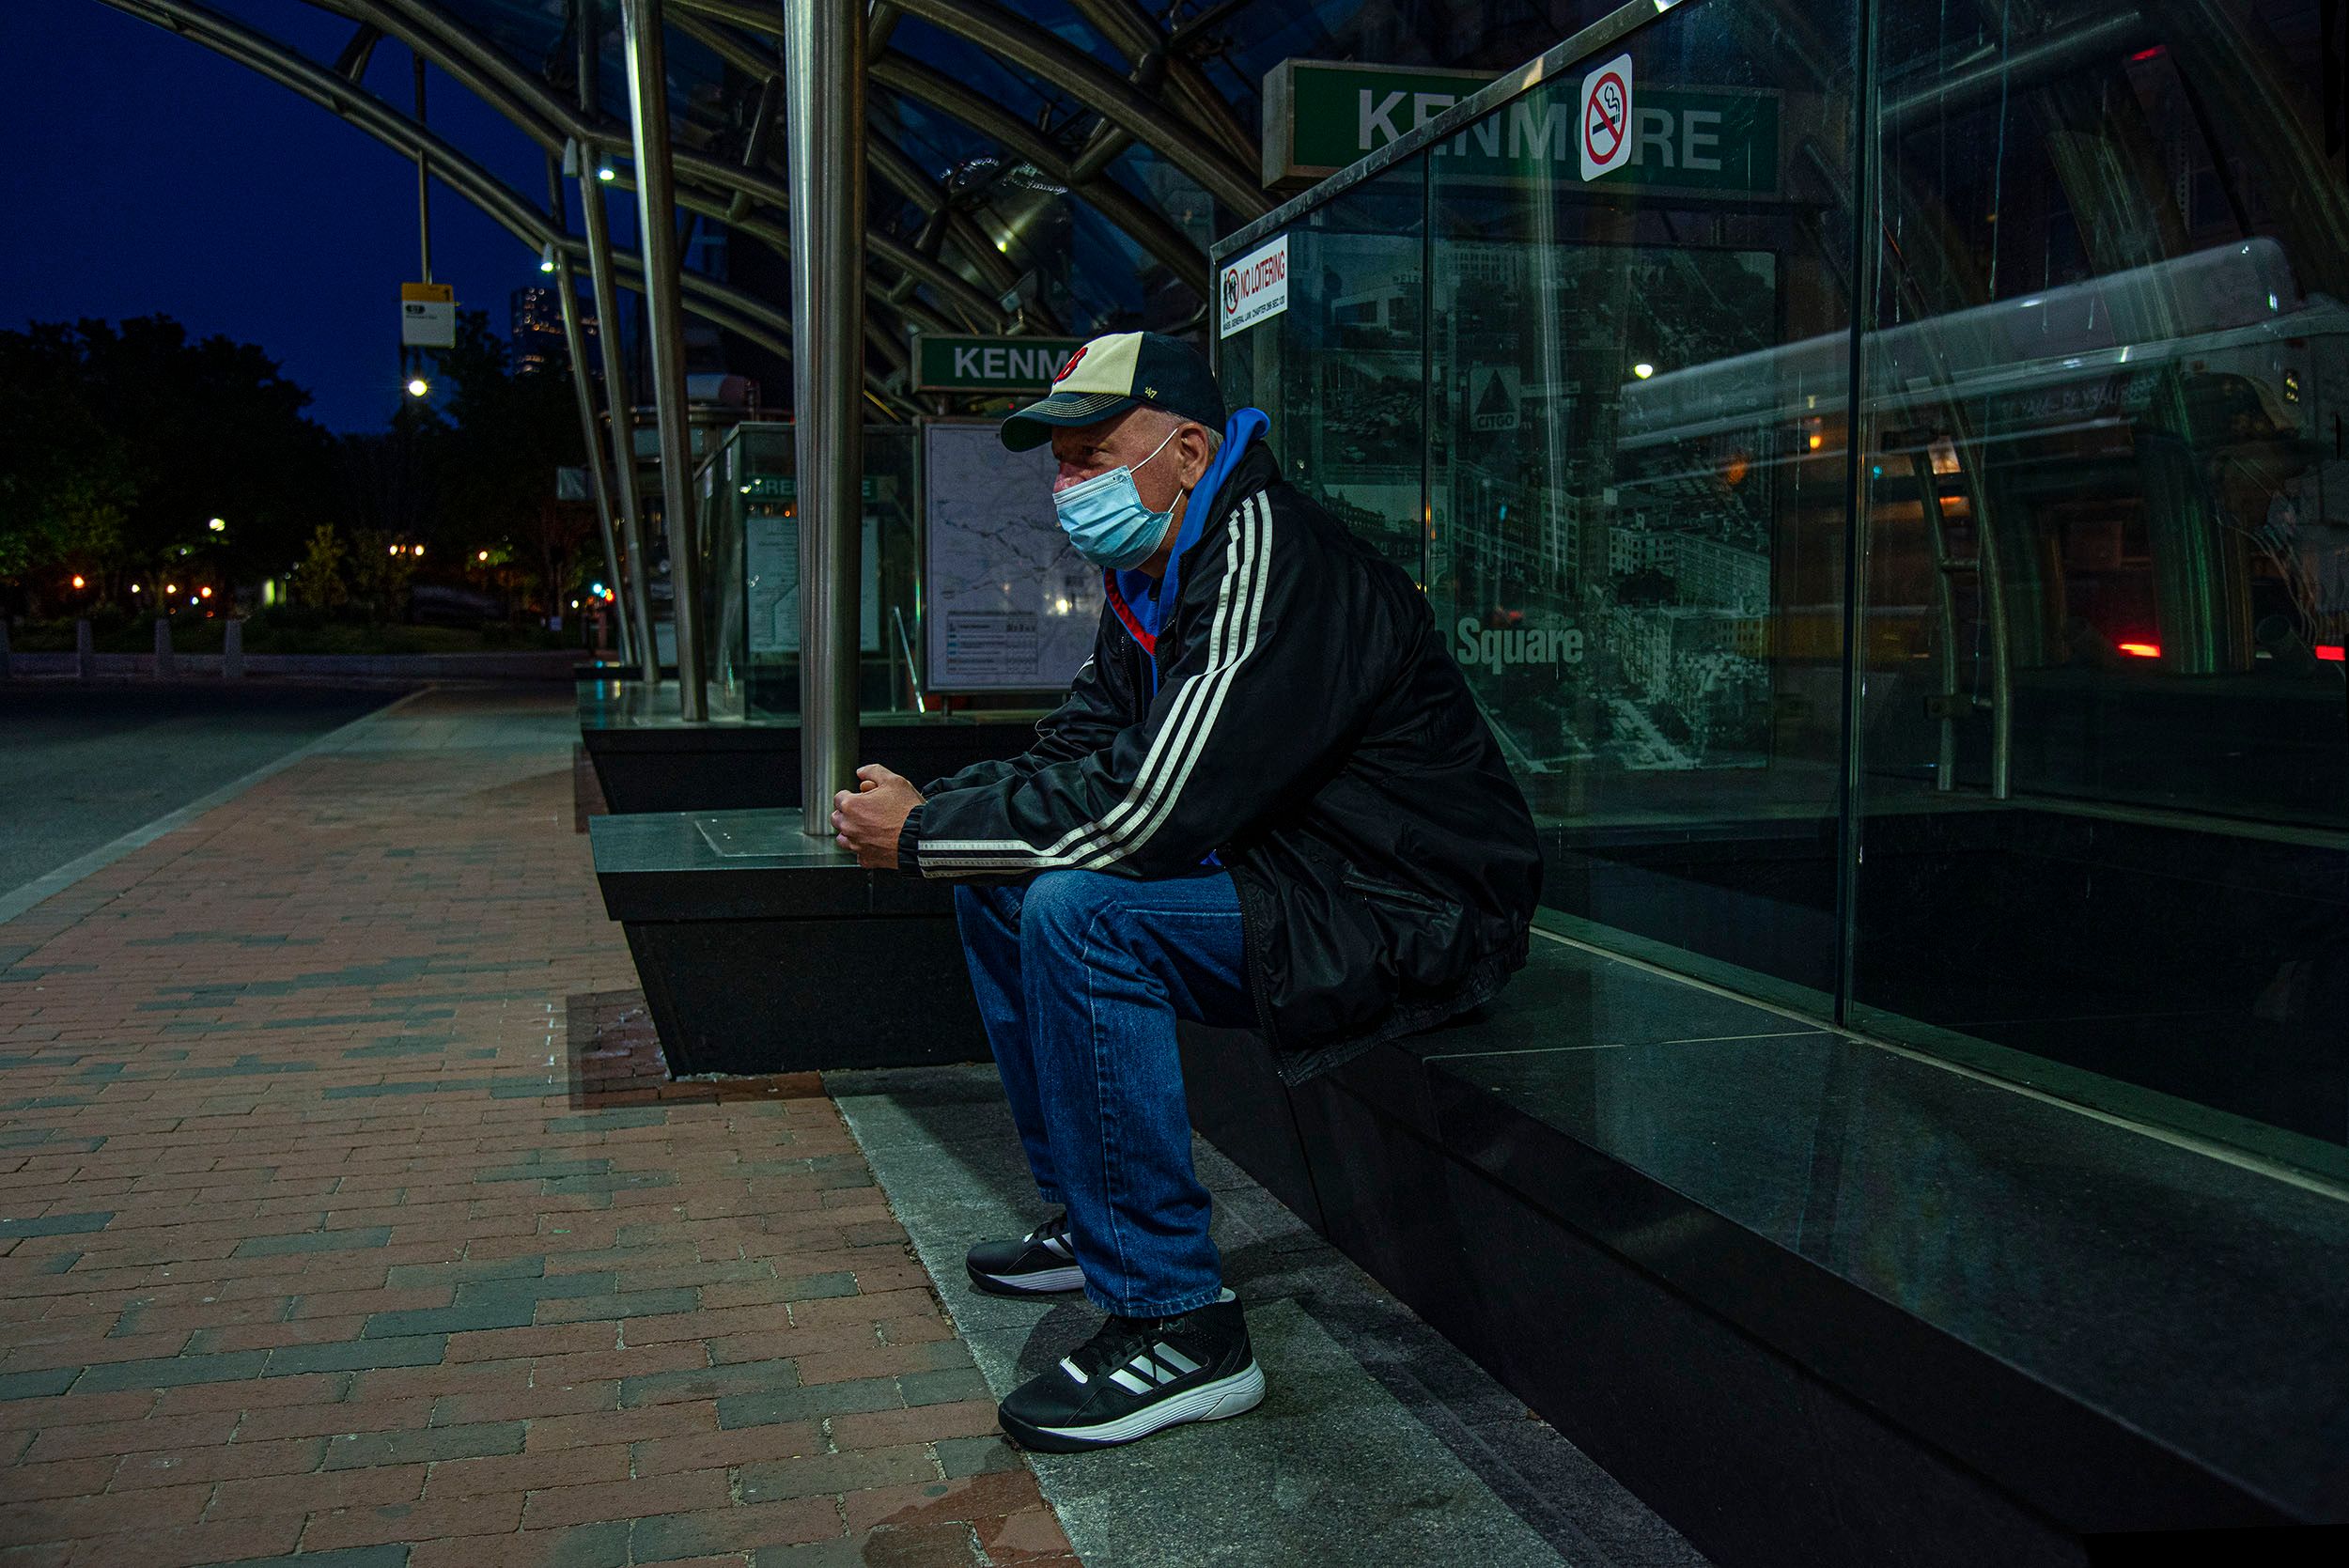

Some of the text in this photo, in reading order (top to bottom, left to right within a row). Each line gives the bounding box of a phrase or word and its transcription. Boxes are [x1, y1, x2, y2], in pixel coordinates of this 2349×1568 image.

[1359, 89, 1721, 170] KENMRE
[1240, 250, 1285, 300] NO LOITERING
[1477, 413, 1515, 428] CITGO
[1457, 617, 1584, 675] Square
